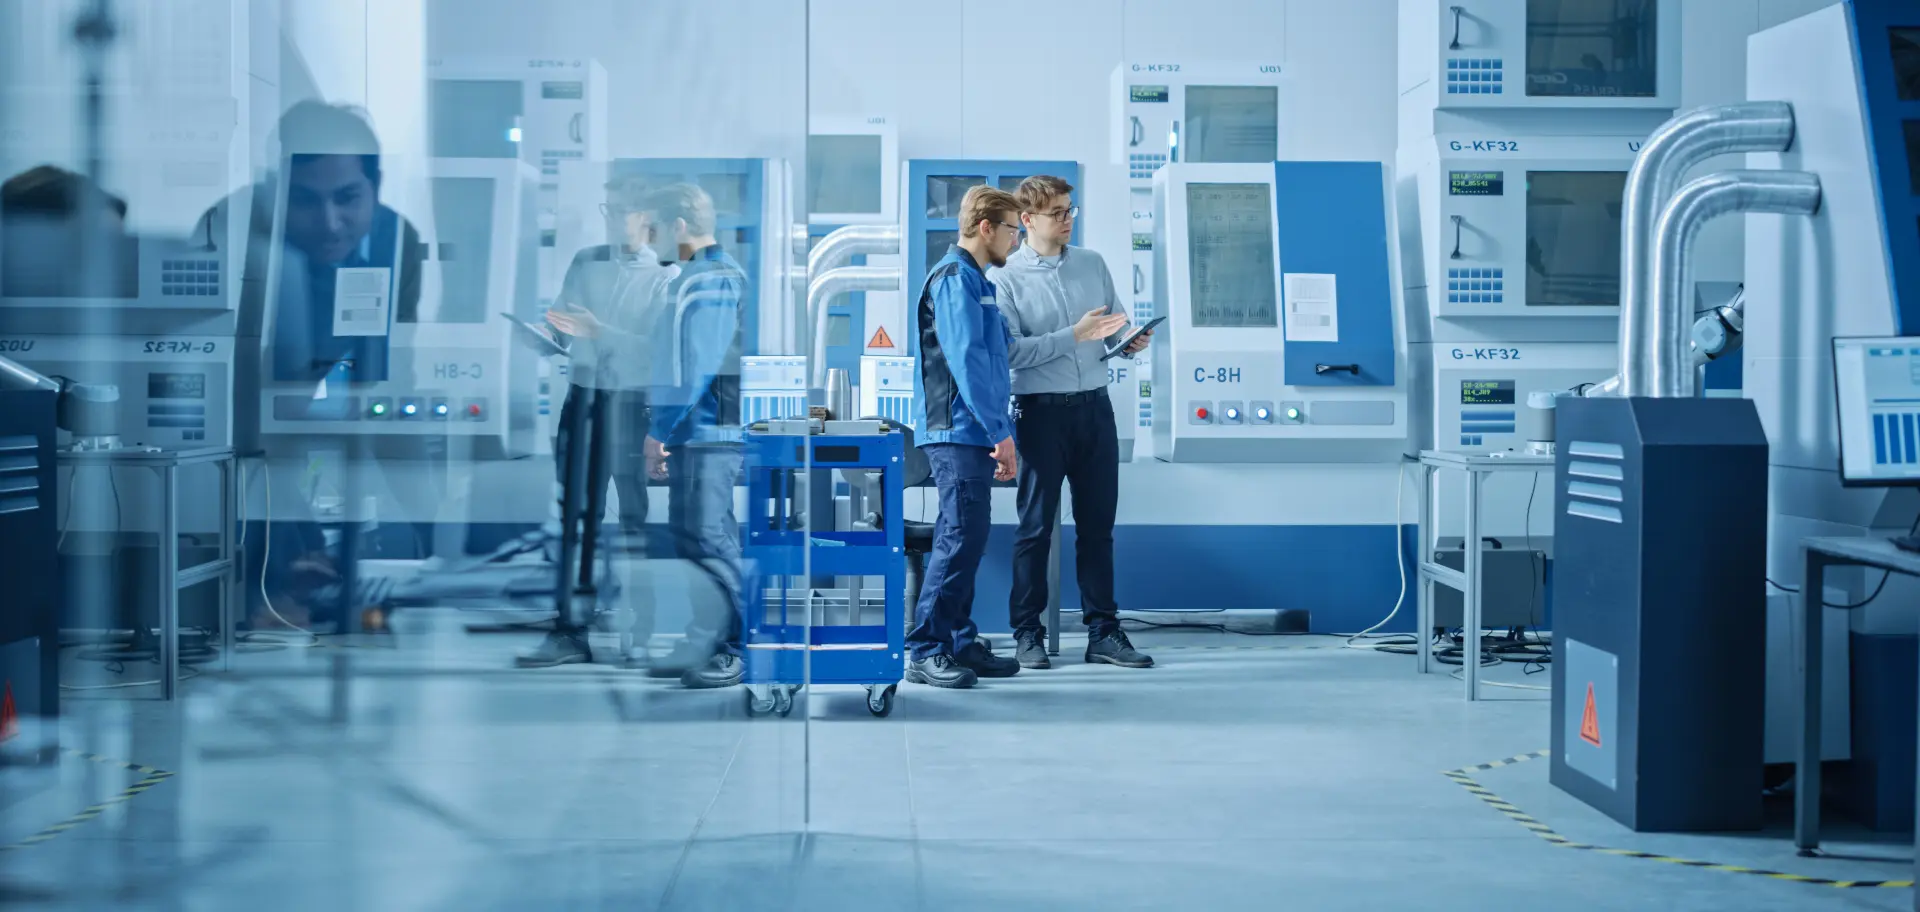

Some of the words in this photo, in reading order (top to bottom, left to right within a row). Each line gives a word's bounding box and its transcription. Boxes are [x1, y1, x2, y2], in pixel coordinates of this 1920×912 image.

[1132, 64, 1181, 72] G-KF32
[1259, 65, 1282, 73] U01
[1450, 140, 1519, 152] G-KF32
[1628, 141, 1643, 152] U
[1451, 348, 1521, 360] G-KF32
[1194, 367, 1241, 383] C-8H
